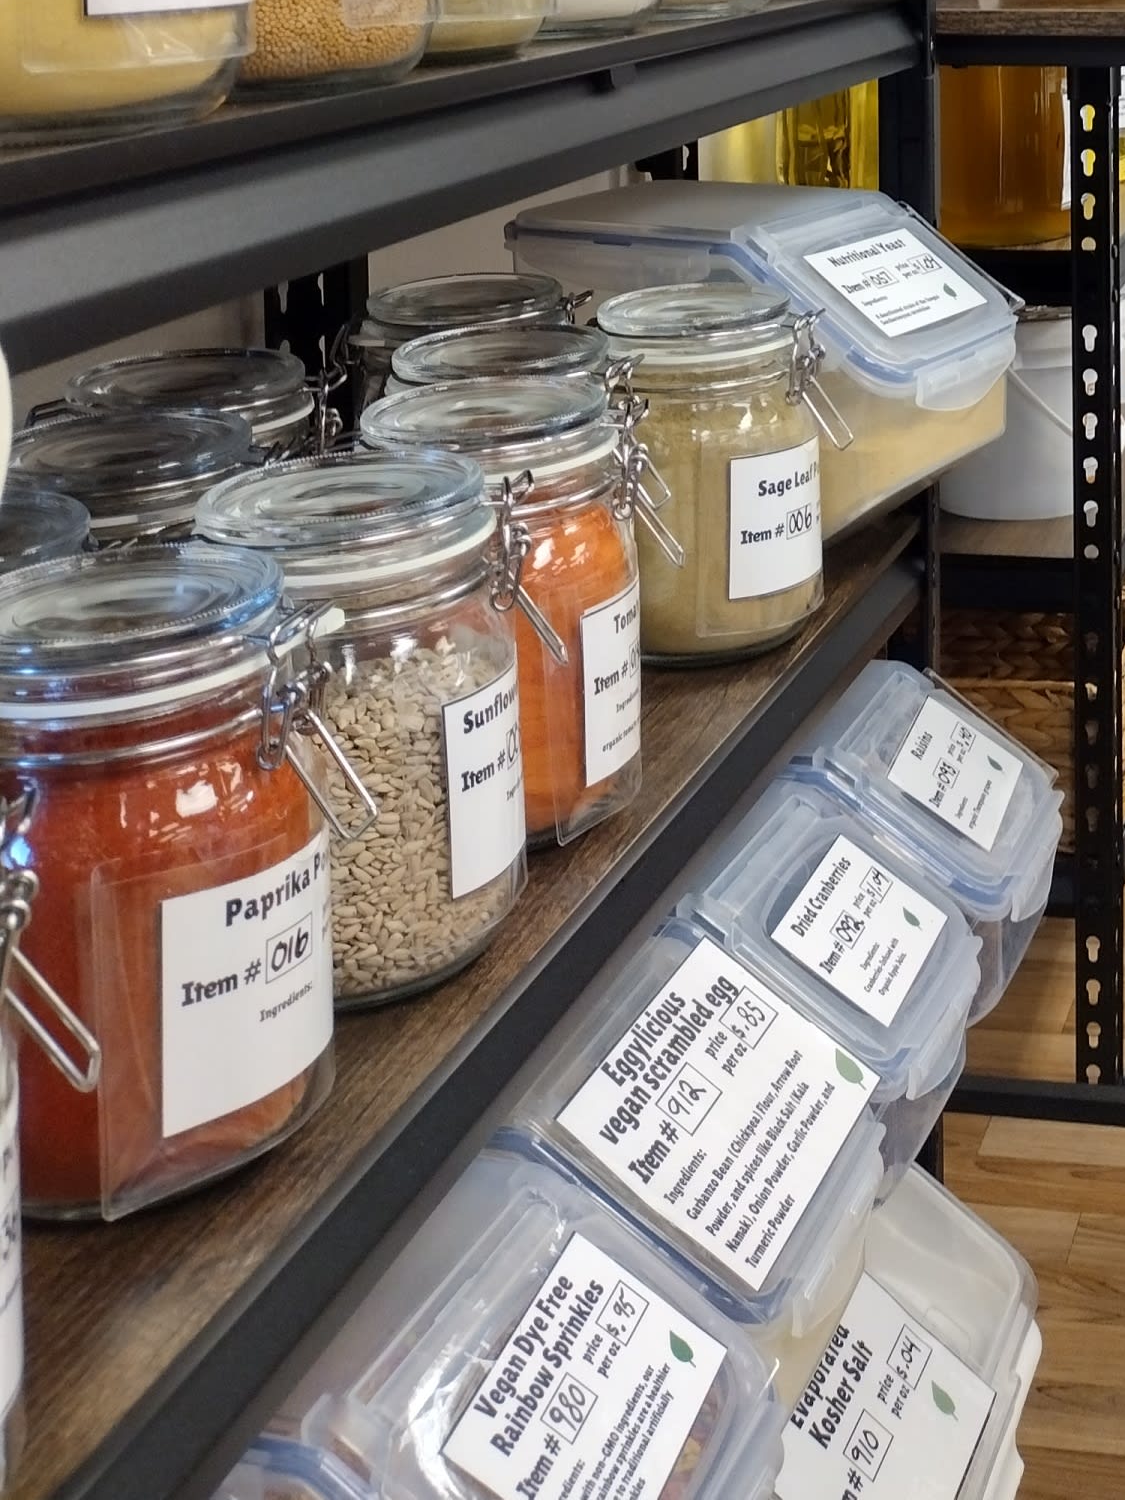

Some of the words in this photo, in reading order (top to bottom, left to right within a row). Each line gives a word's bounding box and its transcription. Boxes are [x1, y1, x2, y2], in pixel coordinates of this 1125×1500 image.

[827, 243, 880, 268] Nutritional
[879, 238, 907, 257] Yeast
[841, 282, 866, 295] Item
[758, 478, 792, 497] Sage
[795, 463, 813, 488] Leaf
[741, 527, 772, 545] Item
[775, 523, 785, 538] #
[789, 505, 812, 534] 006
[594, 669, 620, 696] Item
[621, 660, 628, 678] #
[910, 731, 933, 761] Raisins
[461, 761, 495, 793] Item
[497, 748, 506, 772] #
[928, 790, 945, 809] Item
[225, 867, 310, 927] Paprika
[790, 905, 817, 939] Dried
[808, 857, 852, 911] Cranberries
[852, 891, 866, 910] price
[863, 906, 873, 920] per
[181, 974, 238, 1008] Item
[244, 957, 262, 985] #
[819, 950, 841, 975] Item
[259, 982, 314, 1023] Ingredients:
[599, 1085, 653, 1145] vegan
[648, 997, 716, 1091] scrambled
[708, 973, 740, 1010] egg
[601, 990, 687, 1087] Eggylicious
[705, 1030, 729, 1060] price
[721, 1053, 739, 1077] per
[734, 1042, 748, 1060] oz
[628, 1136, 672, 1185] Item
[660, 1119, 681, 1145] #
[685, 1178, 720, 1222] Garbanzo
[712, 1155, 734, 1185] Bean
[728, 1108, 764, 1160] (Chickpea)
[755, 1089, 779, 1117] Flour,
[770, 1067, 791, 1093] Arrow
[785, 1049, 804, 1072] Root
[663, 1148, 708, 1206] Ingredients:
[705, 1199, 738, 1237] Powder,
[730, 1177, 747, 1201] and
[742, 1155, 764, 1183] spices
[755, 1139, 774, 1160] like
[769, 1115, 789, 1144] Black
[781, 1101, 797, 1121] Salt
[724, 1213, 758, 1254] Namak),
[748, 1183, 773, 1217] Onion
[764, 1153, 796, 1190] Powder,
[786, 1128, 807, 1154] Garlic
[800, 1095, 828, 1133] Powder,
[821, 1080, 836, 1100] and
[745, 1225, 776, 1269] Turmeric
[768, 1192, 797, 1233] Powder
[473, 1351, 528, 1421] Vegan
[513, 1313, 551, 1360] Dye
[536, 1274, 574, 1321] Free
[490, 1366, 555, 1458] Rainbow
[542, 1278, 606, 1369] Sprinkles
[582, 1333, 604, 1366] price
[597, 1357, 613, 1379] per
[608, 1342, 622, 1361] oz
[808, 1375, 852, 1450] Kosher
[846, 1339, 874, 1383] Salt
[876, 1373, 895, 1405] price
[890, 1398, 903, 1420] per
[899, 1383, 911, 1399] oz
[591, 1431, 620, 1481] non-GMO
[616, 1381, 650, 1433] ingredients,
[642, 1364, 656, 1383] our
[616, 1422, 642, 1465] sprinkles
[638, 1406, 650, 1423] are
[647, 1362, 672, 1402] healthier
[515, 1452, 556, 1500] Item
[543, 1432, 562, 1458] #
[616, 1483, 626, 1497] to
[621, 1432, 651, 1486] traditional
[648, 1389, 675, 1438] artificially
